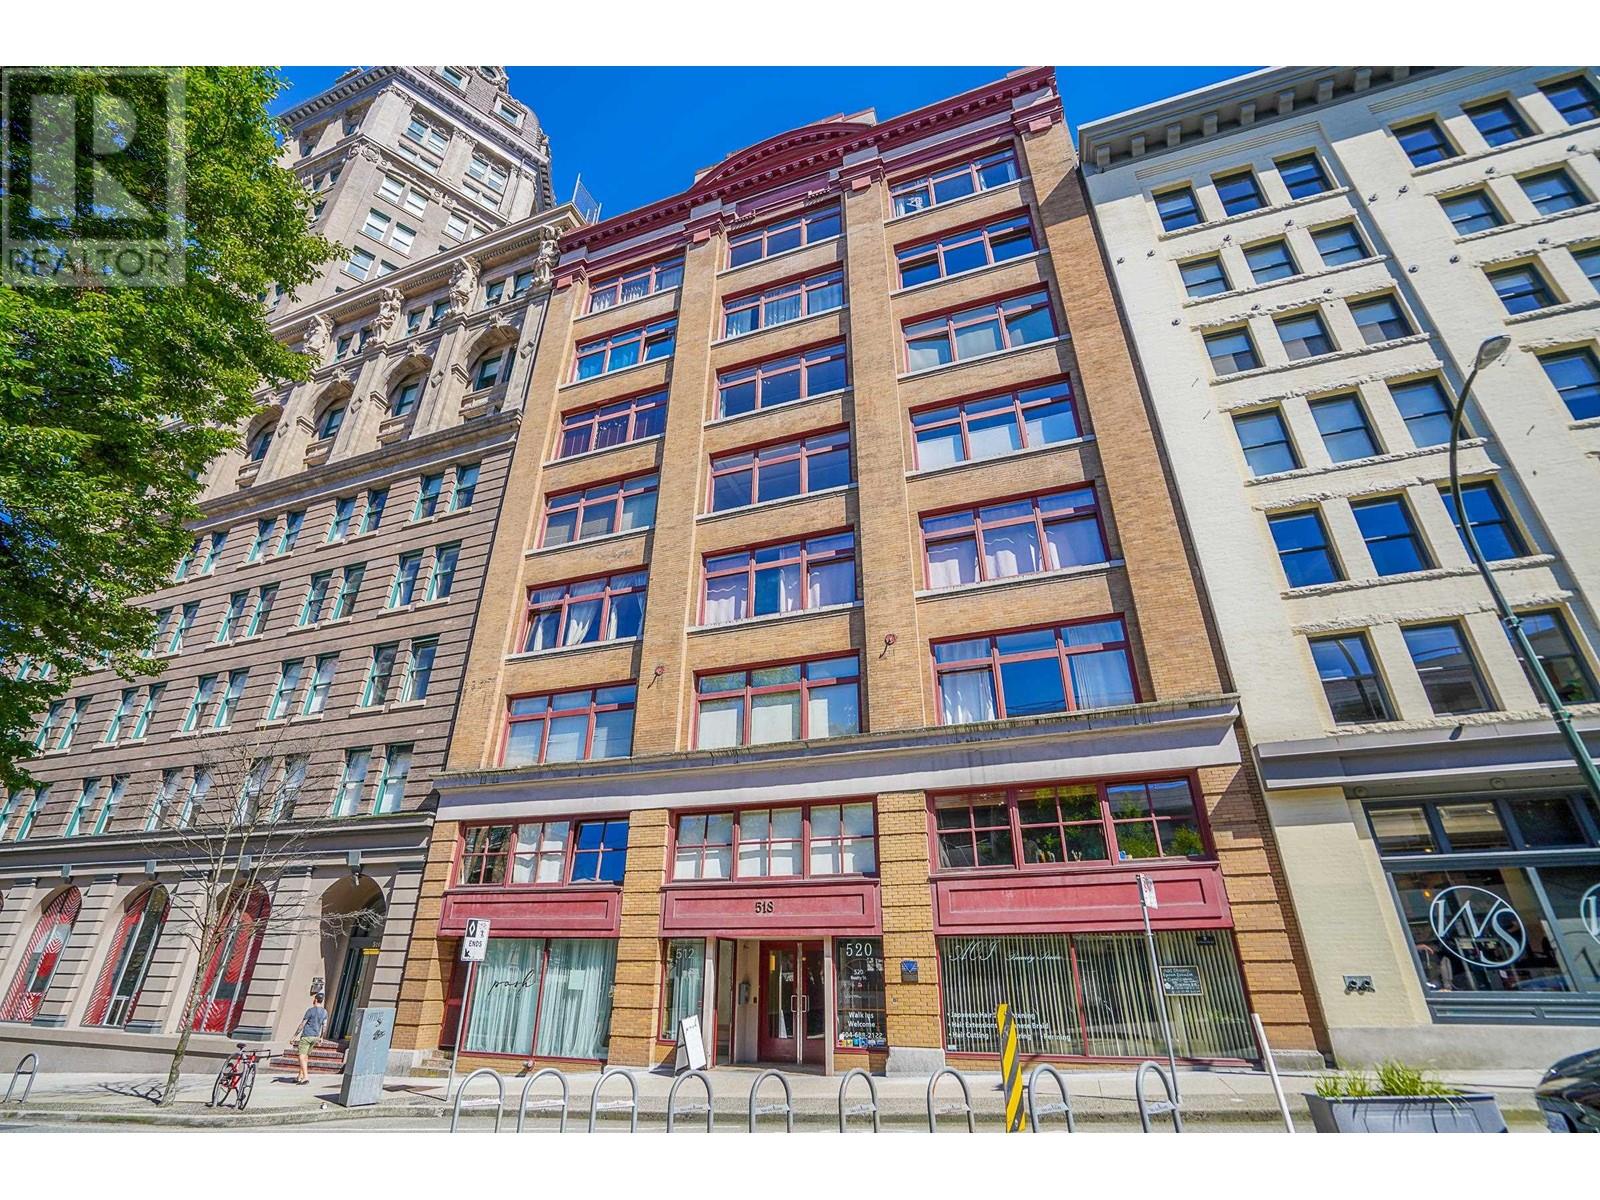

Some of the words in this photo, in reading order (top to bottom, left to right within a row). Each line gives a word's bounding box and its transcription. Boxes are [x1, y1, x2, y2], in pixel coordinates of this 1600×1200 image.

[755, 901, 774, 914] 518
[468, 940, 482, 948] ENDS
[676, 948, 694, 959] 512
[846, 943, 872, 957] 520
[488, 969, 536, 995] posh
[848, 1011, 864, 1019] Walk
[951, 1011, 978, 1020] Japanese
[848, 1020, 875, 1028] Welcome
[966, 1031, 989, 1040] Cutting
